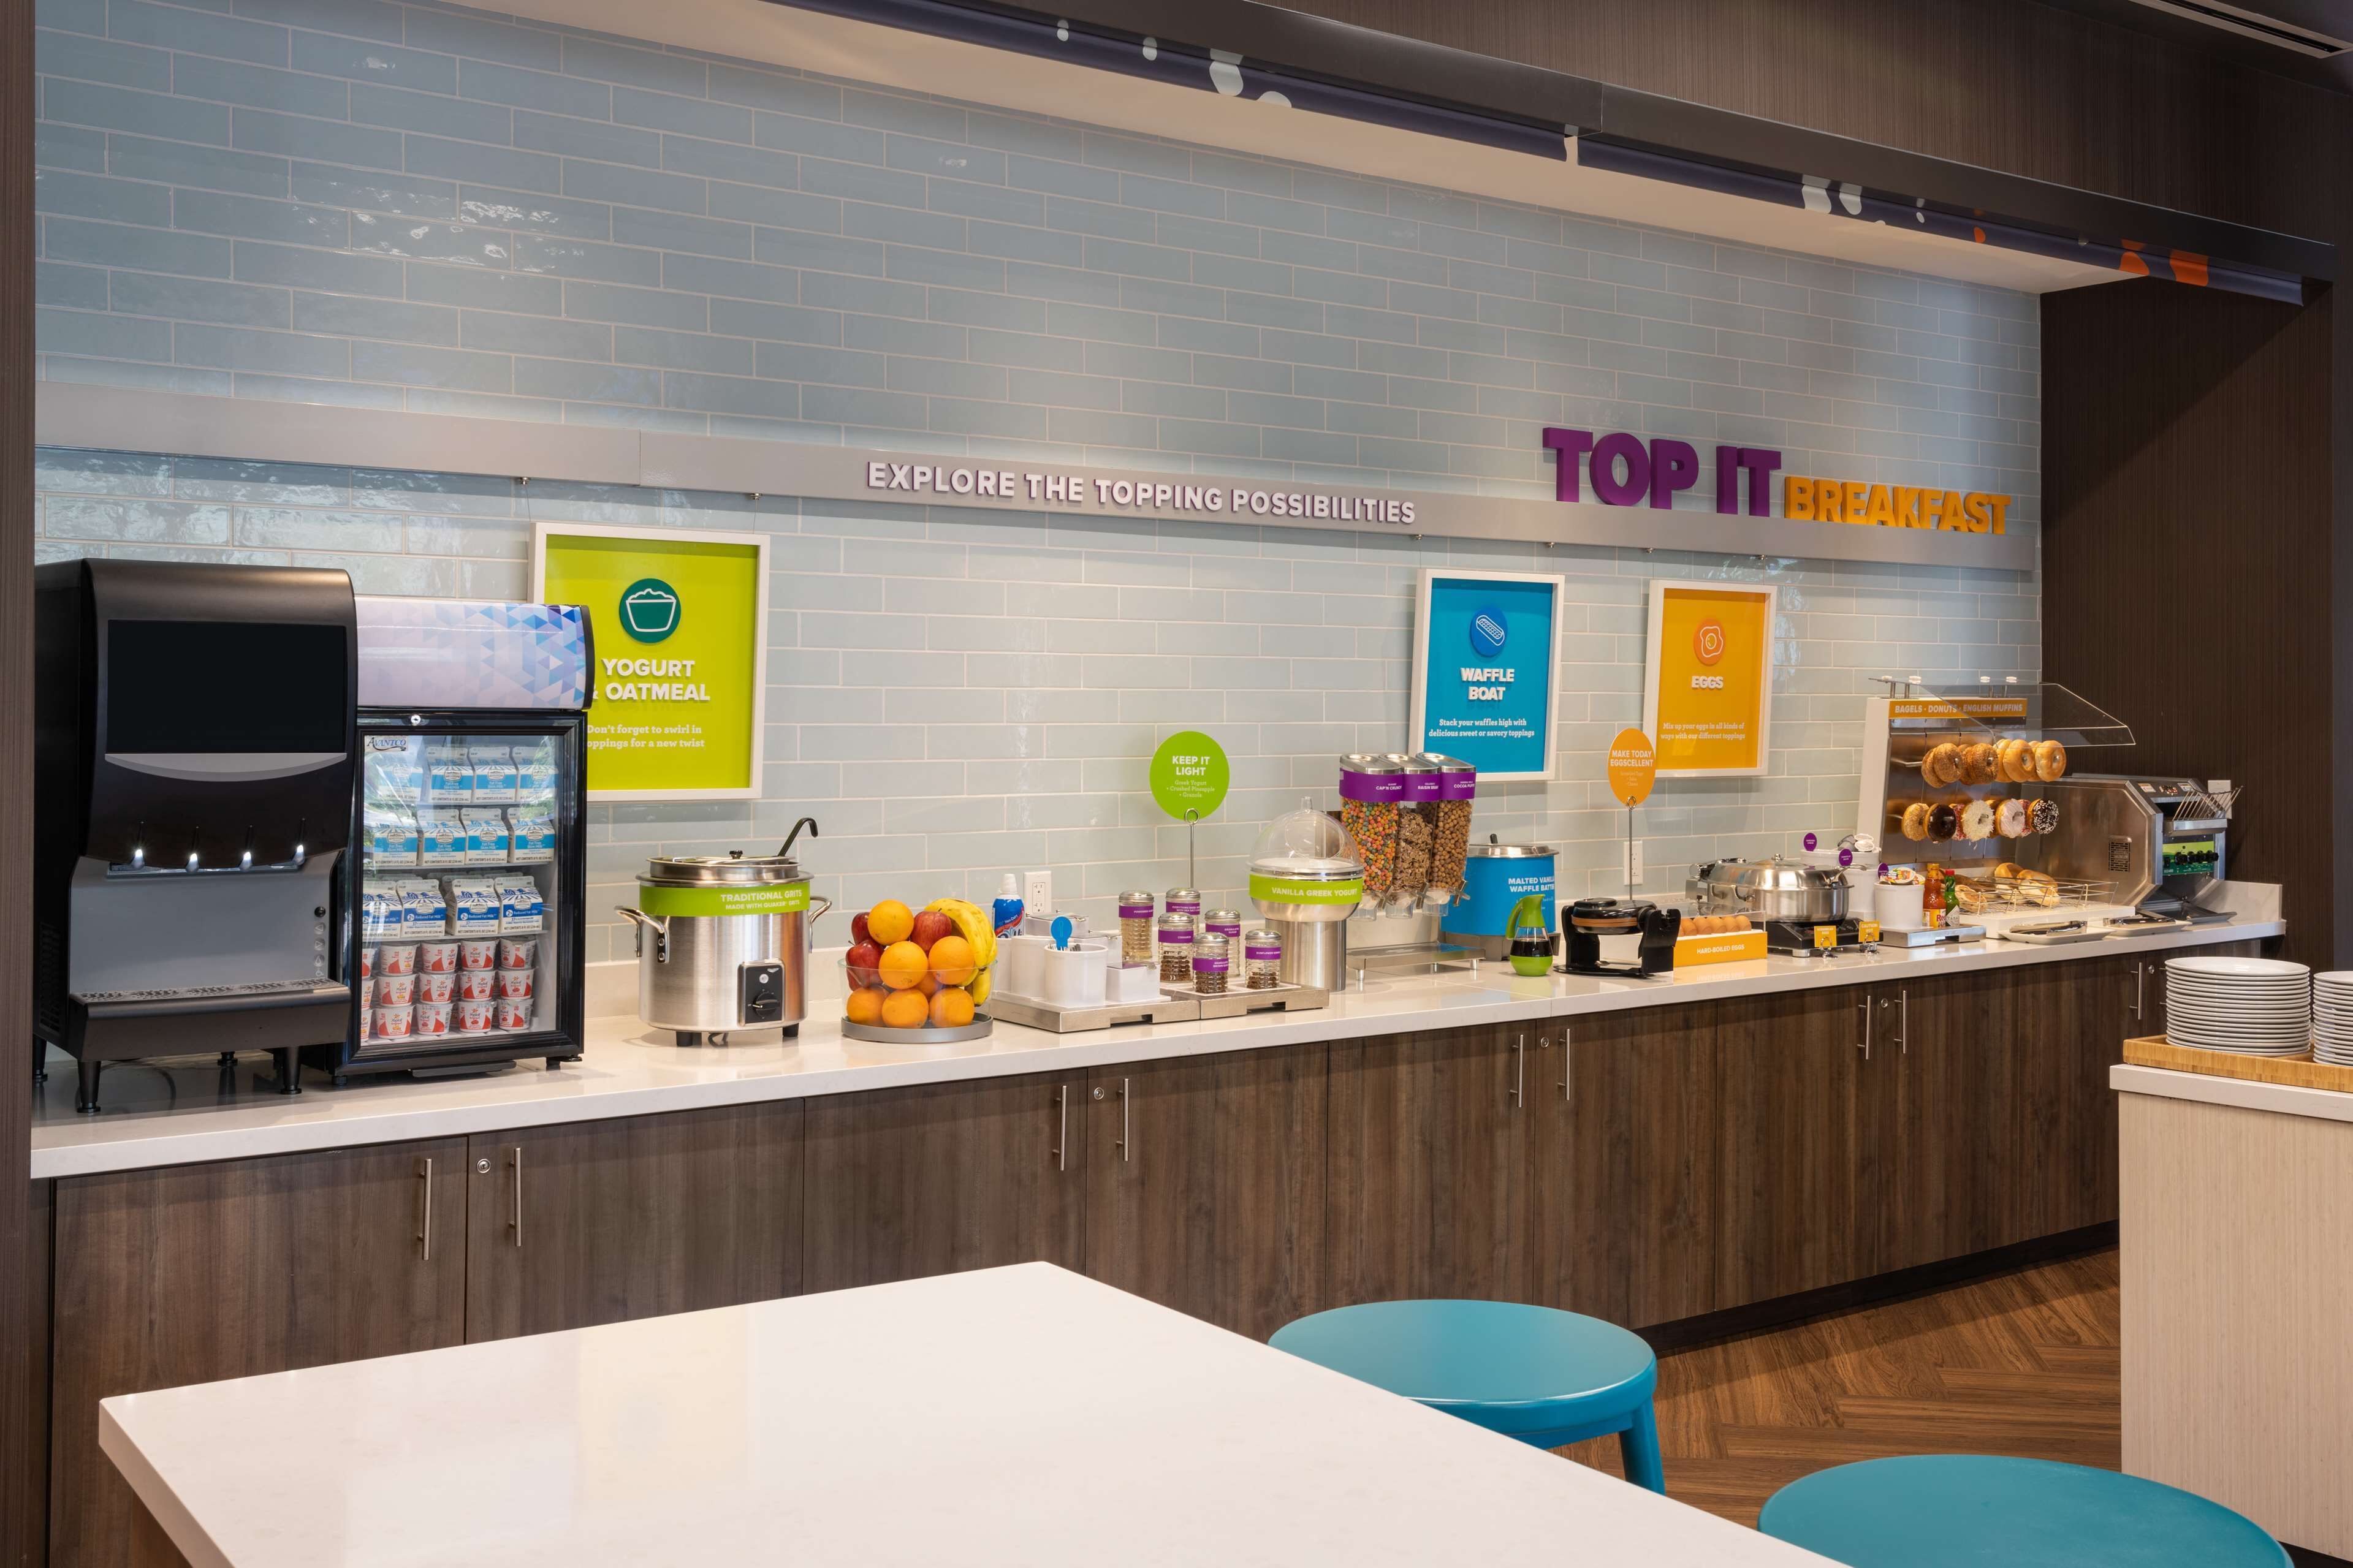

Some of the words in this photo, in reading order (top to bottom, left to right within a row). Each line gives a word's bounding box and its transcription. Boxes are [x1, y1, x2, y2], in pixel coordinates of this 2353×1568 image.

[1542, 427, 1699, 510] TOP
[1716, 445, 1781, 517] IT
[867, 461, 1015, 498] EXPLORE
[1024, 474, 1083, 502] THE
[1094, 479, 1222, 512] TOPPING
[1231, 489, 1416, 525] POSSIBILITIES
[1785, 476, 2011, 535] BREAKFAST
[602, 658, 695, 677] YOGURT
[1461, 667, 1515, 682] WAFFLE
[1692, 676, 1724, 689] EGGS
[606, 683, 710, 701] OATMEAL
[1468, 687, 1505, 700] BOAT
[1499, 718, 1512, 727] high
[587, 725, 615, 733] Don't
[617, 724, 649, 735] forget
[664, 725, 690, 733] swirl
[692, 725, 701, 733] in
[1508, 729, 1535, 738] toppings
[587, 738, 628, 749] oppings
[630, 738, 646, 747] for
[679, 738, 704, 747] twist
[1172, 756, 1198, 764] KEEP
[1176, 767, 1206, 776] LIGHT
[720, 892, 783, 903] TRADITIONAL
[785, 890, 802, 898] GRITS
[1272, 887, 1304, 896] VANILLA
[1697, 945, 1730, 954] HARD-BOILED
